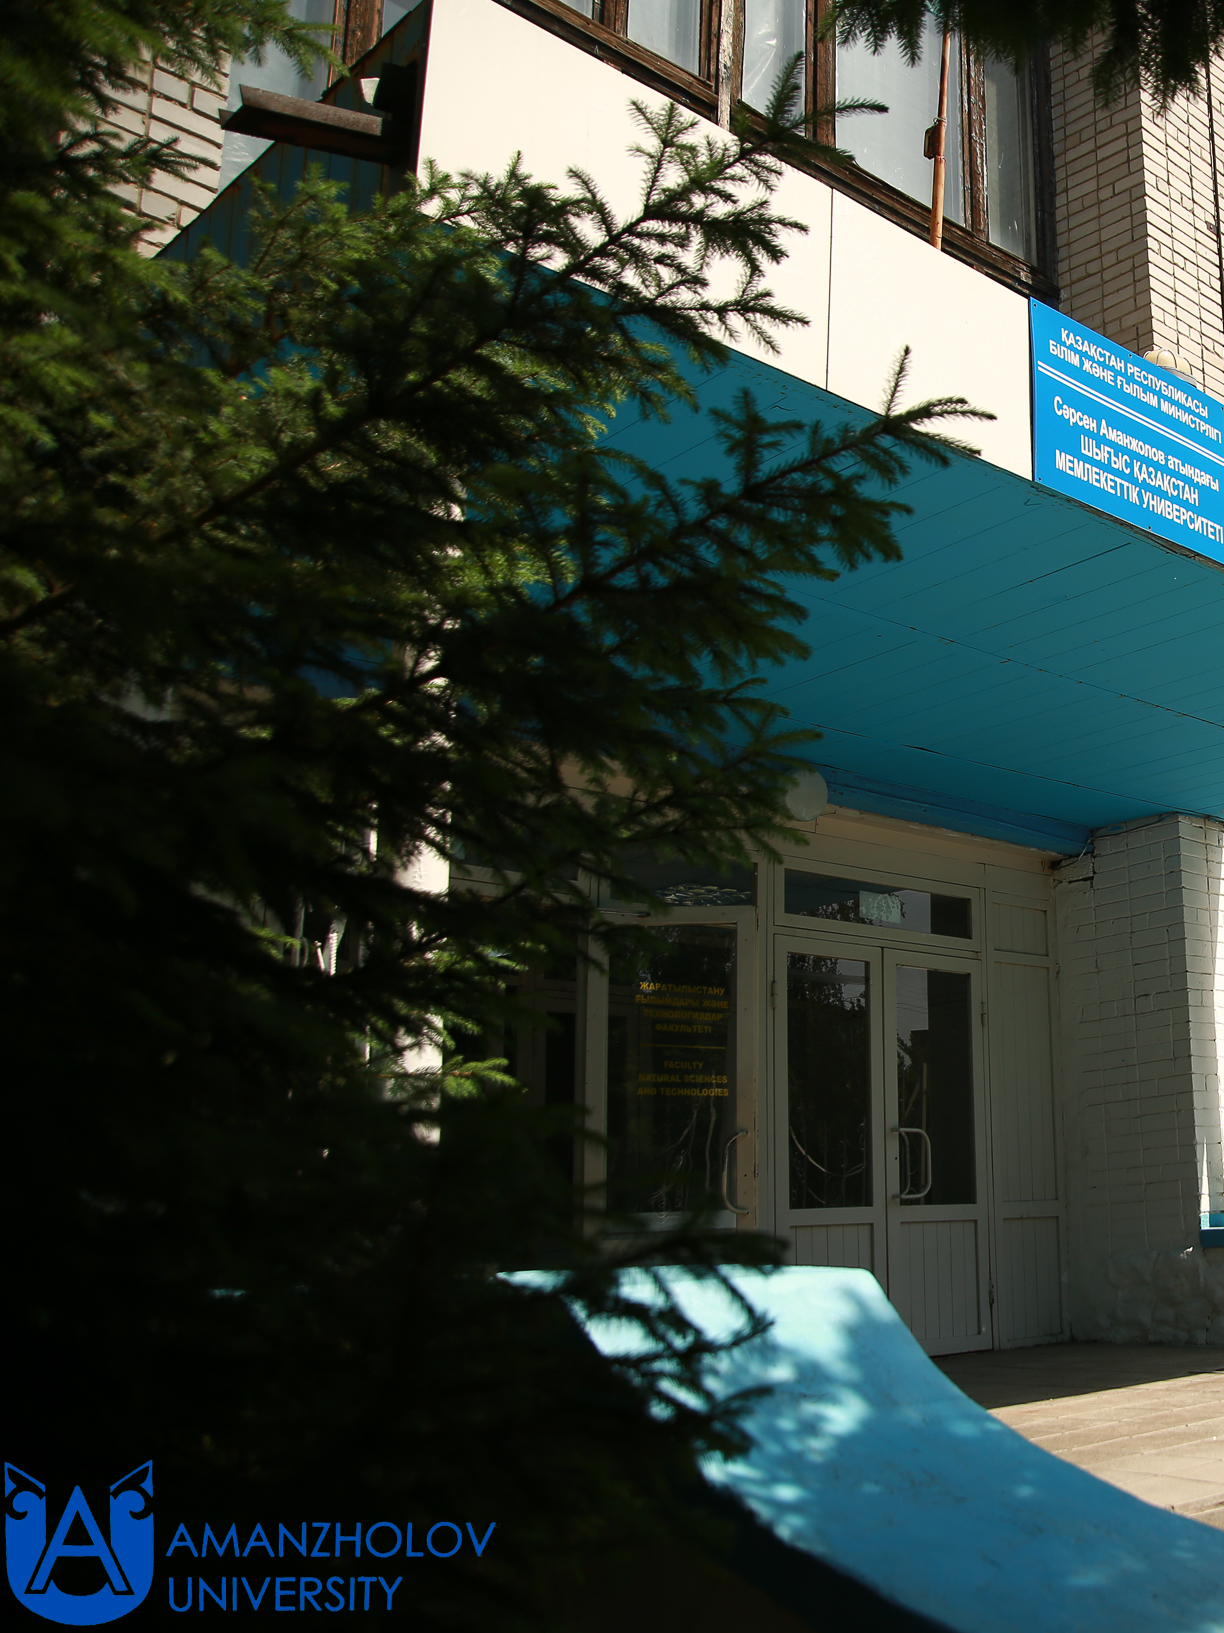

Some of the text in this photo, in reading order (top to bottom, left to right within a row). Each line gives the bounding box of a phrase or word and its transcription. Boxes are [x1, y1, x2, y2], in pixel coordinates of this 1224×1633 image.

[1049, 339, 1080, 369] БІЛІМ
[1082, 355, 1115, 386] ЖӘНЕ
[1116, 373, 1159, 408] ҒЫЛЫМ
[1061, 327, 1209, 419] ҚАЗАҚСТАН РЕСПУБЛИКАСЫ
[1053, 395, 1220, 492] Сәрсен Аманжолов атындағы
[1080, 434, 1131, 475] ШЫҒЫС
[1133, 459, 1200, 507] ҚАЗАҚСТАН
[1055, 449, 1224, 544] МЕМЛЕКЕТТІК УНИВЕРСИТЕТІ
[639, 981, 726, 995] ЖАРАТЫЛЫСТАНУ
[637, 1086, 729, 1097] AND TECHNOLOGIES
[638, 1073, 728, 1084] NATURAL SCIENCES
[663, 1060, 704, 1069] FACULTY
